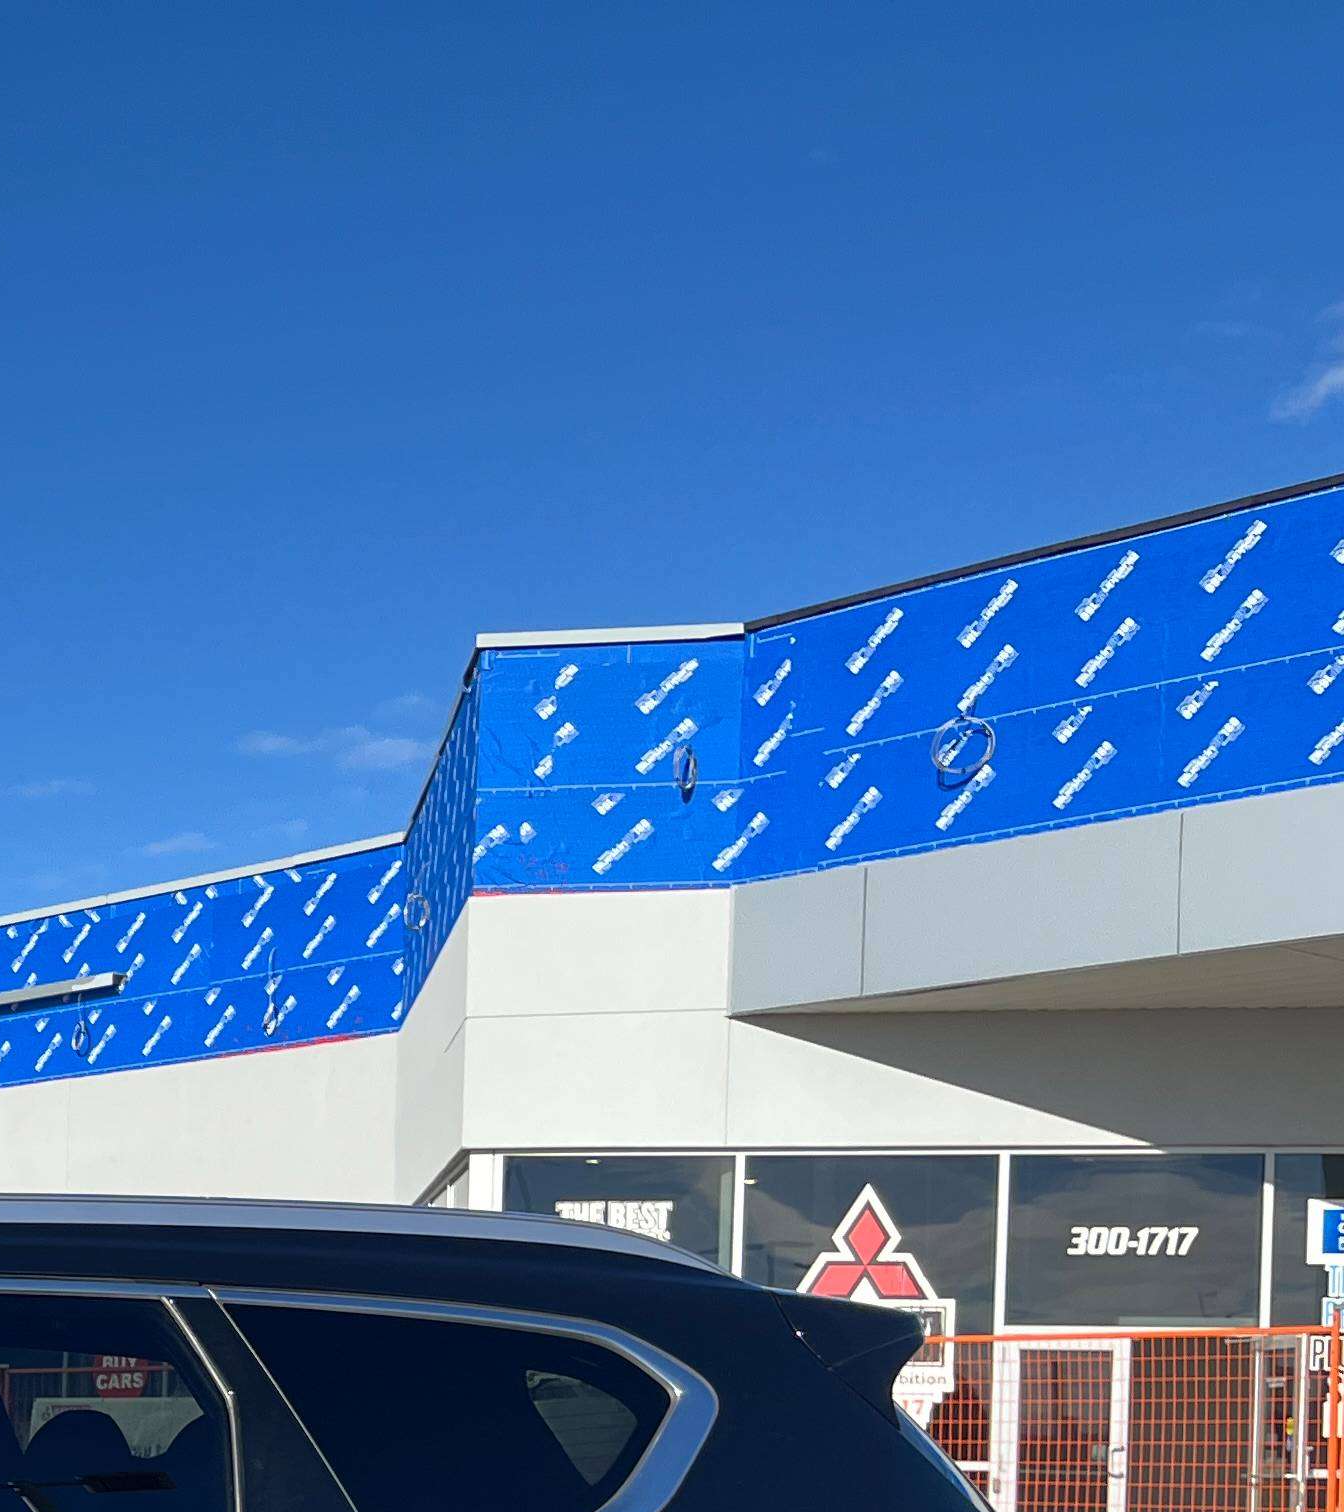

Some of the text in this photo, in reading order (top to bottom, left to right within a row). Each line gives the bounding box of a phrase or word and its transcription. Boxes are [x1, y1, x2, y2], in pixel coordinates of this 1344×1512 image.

[607, 1201, 673, 1231] BEST
[1067, 1226, 1199, 1256] 300-1717
[95, 1371, 145, 1391] CARS
